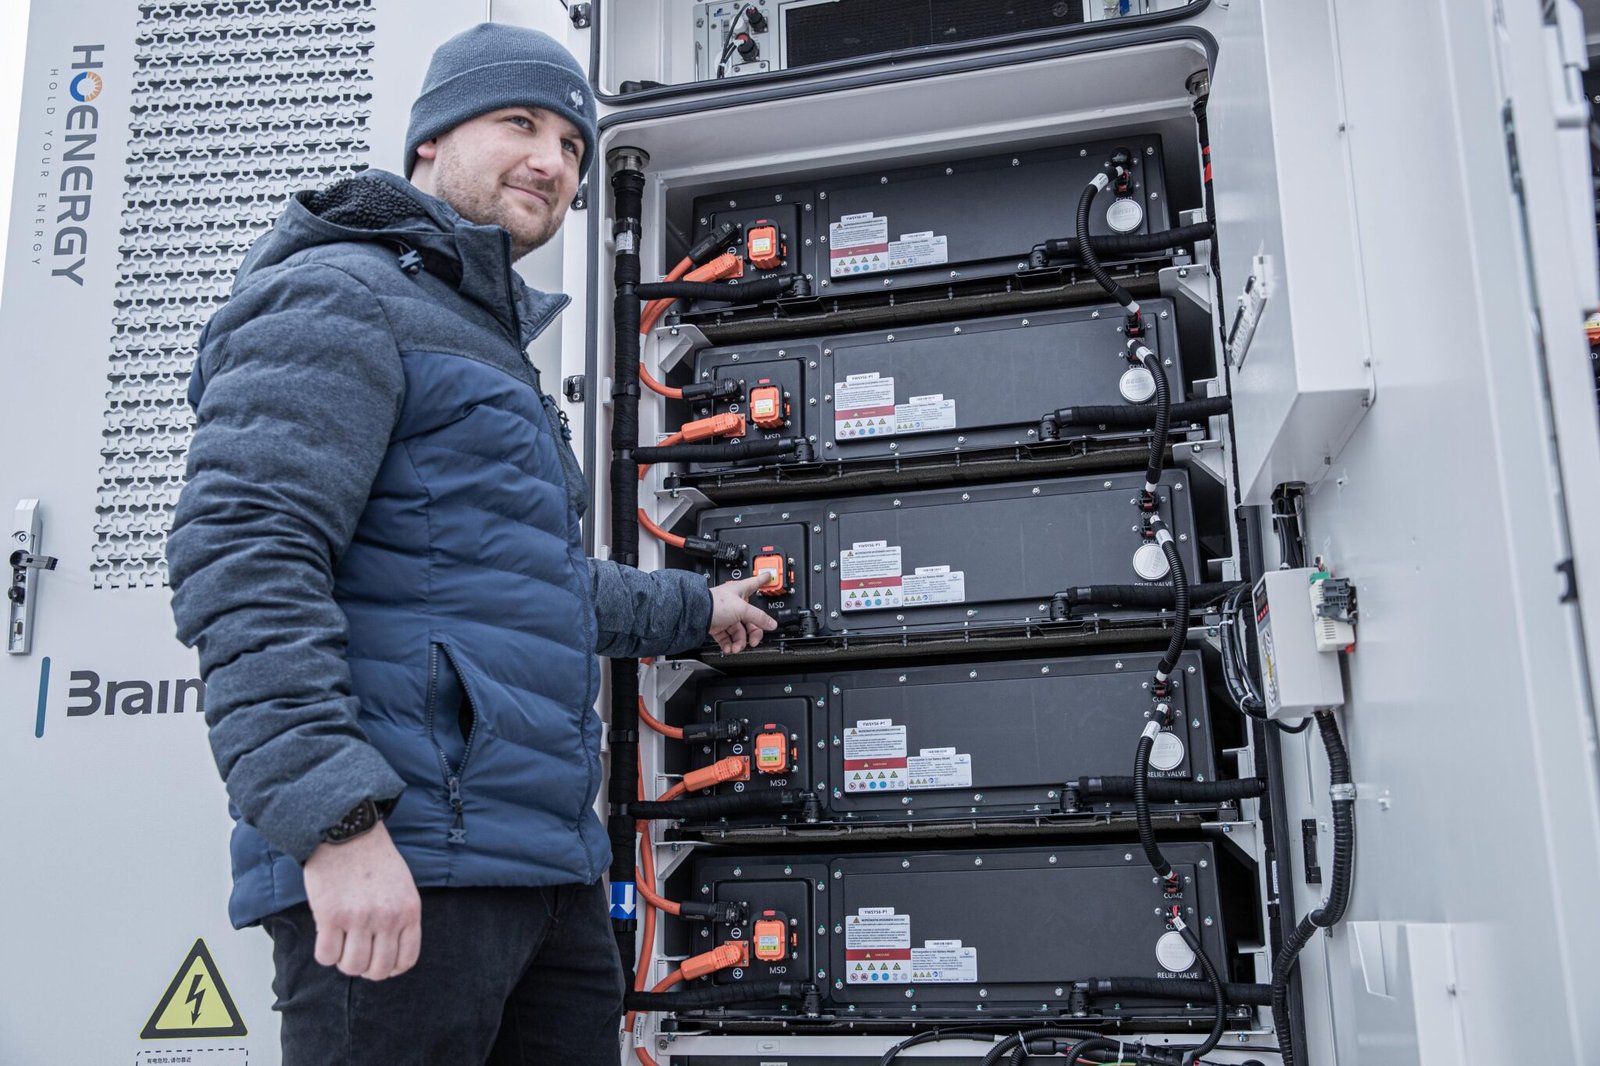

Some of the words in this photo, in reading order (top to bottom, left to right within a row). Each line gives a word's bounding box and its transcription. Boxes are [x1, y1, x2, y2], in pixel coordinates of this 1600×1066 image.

[46, 68, 59, 115] HOLD
[39, 130, 53, 178] YOUR
[51, 44, 105, 286] HOENERGY
[32, 192, 47, 265] ENERGY
[770, 779, 787, 787] MSD
[769, 966, 787, 974] MSD
